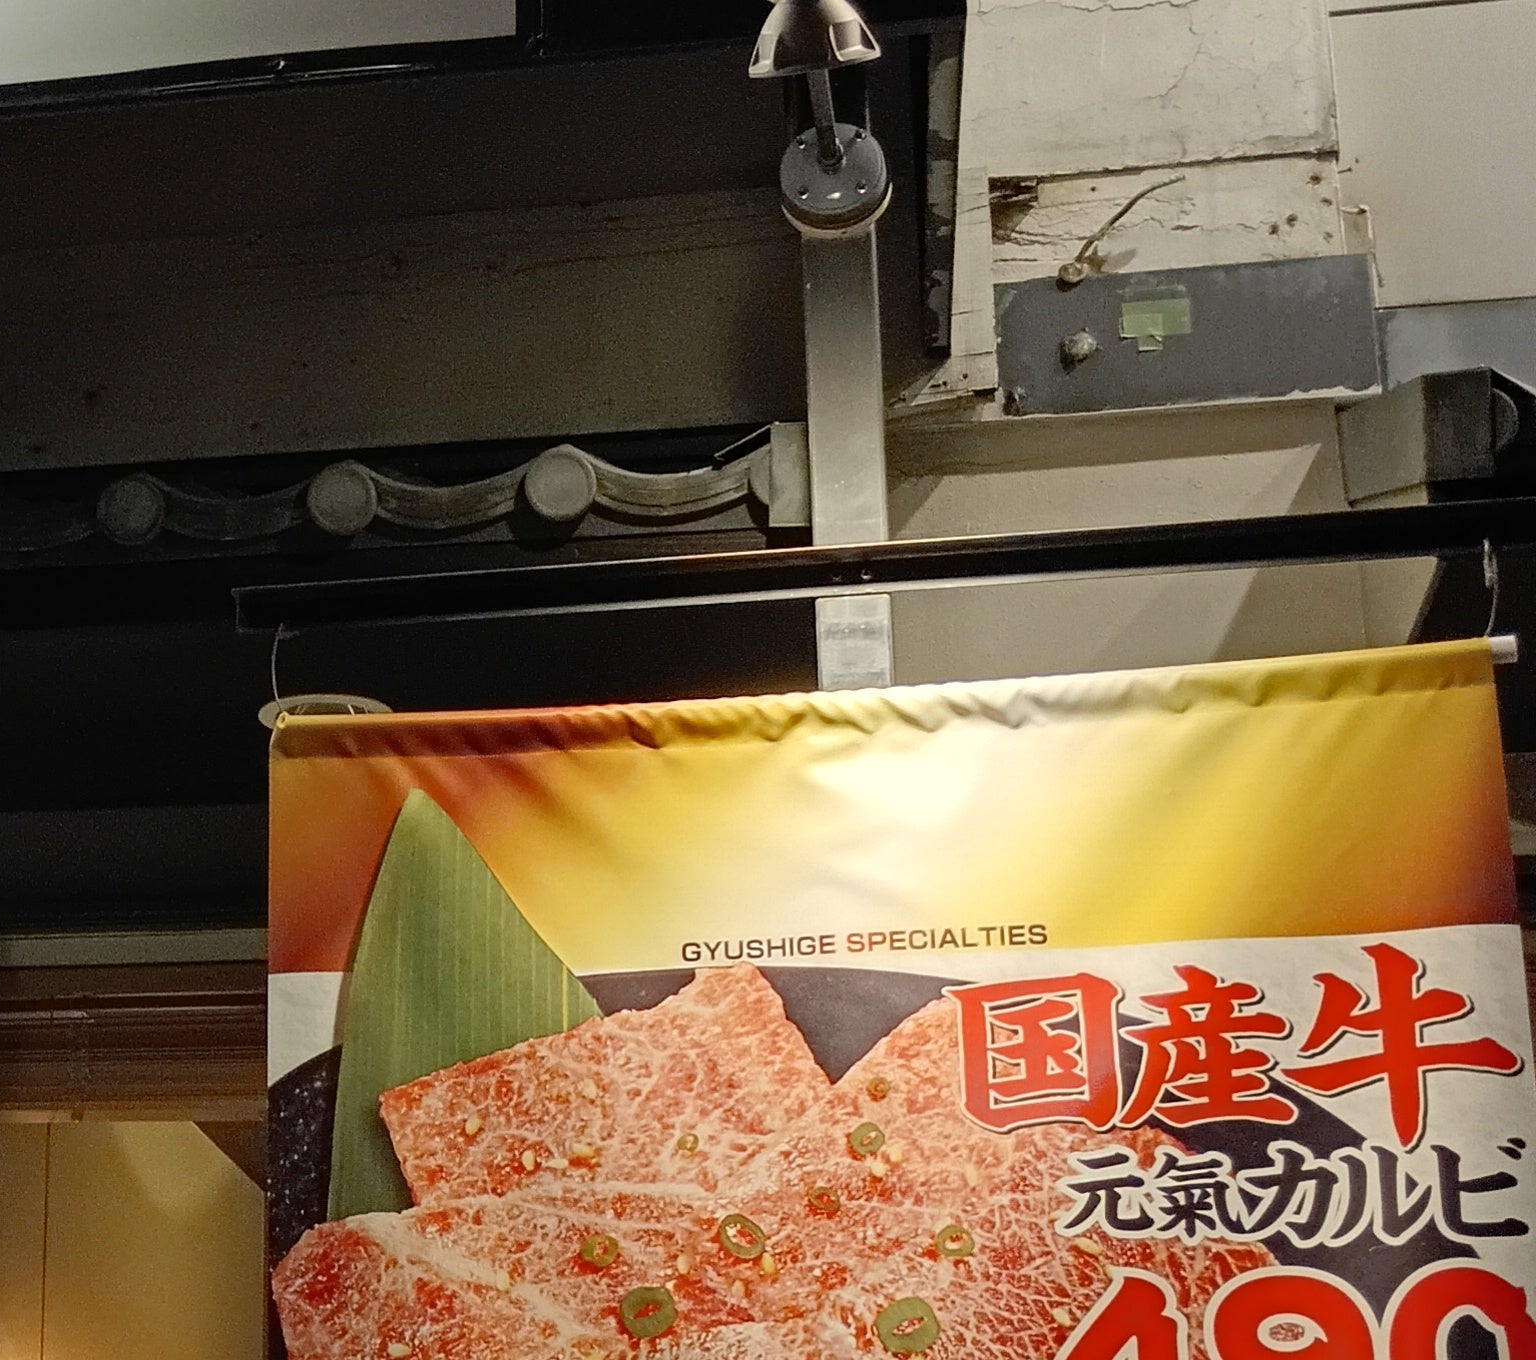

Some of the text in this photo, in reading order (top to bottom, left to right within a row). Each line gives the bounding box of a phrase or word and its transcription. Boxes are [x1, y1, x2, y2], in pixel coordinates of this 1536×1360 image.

[681, 923, 1048, 963] GYUSHIGE SPECIALTIES
[948, 944, 1522, 1146] 国産牛
